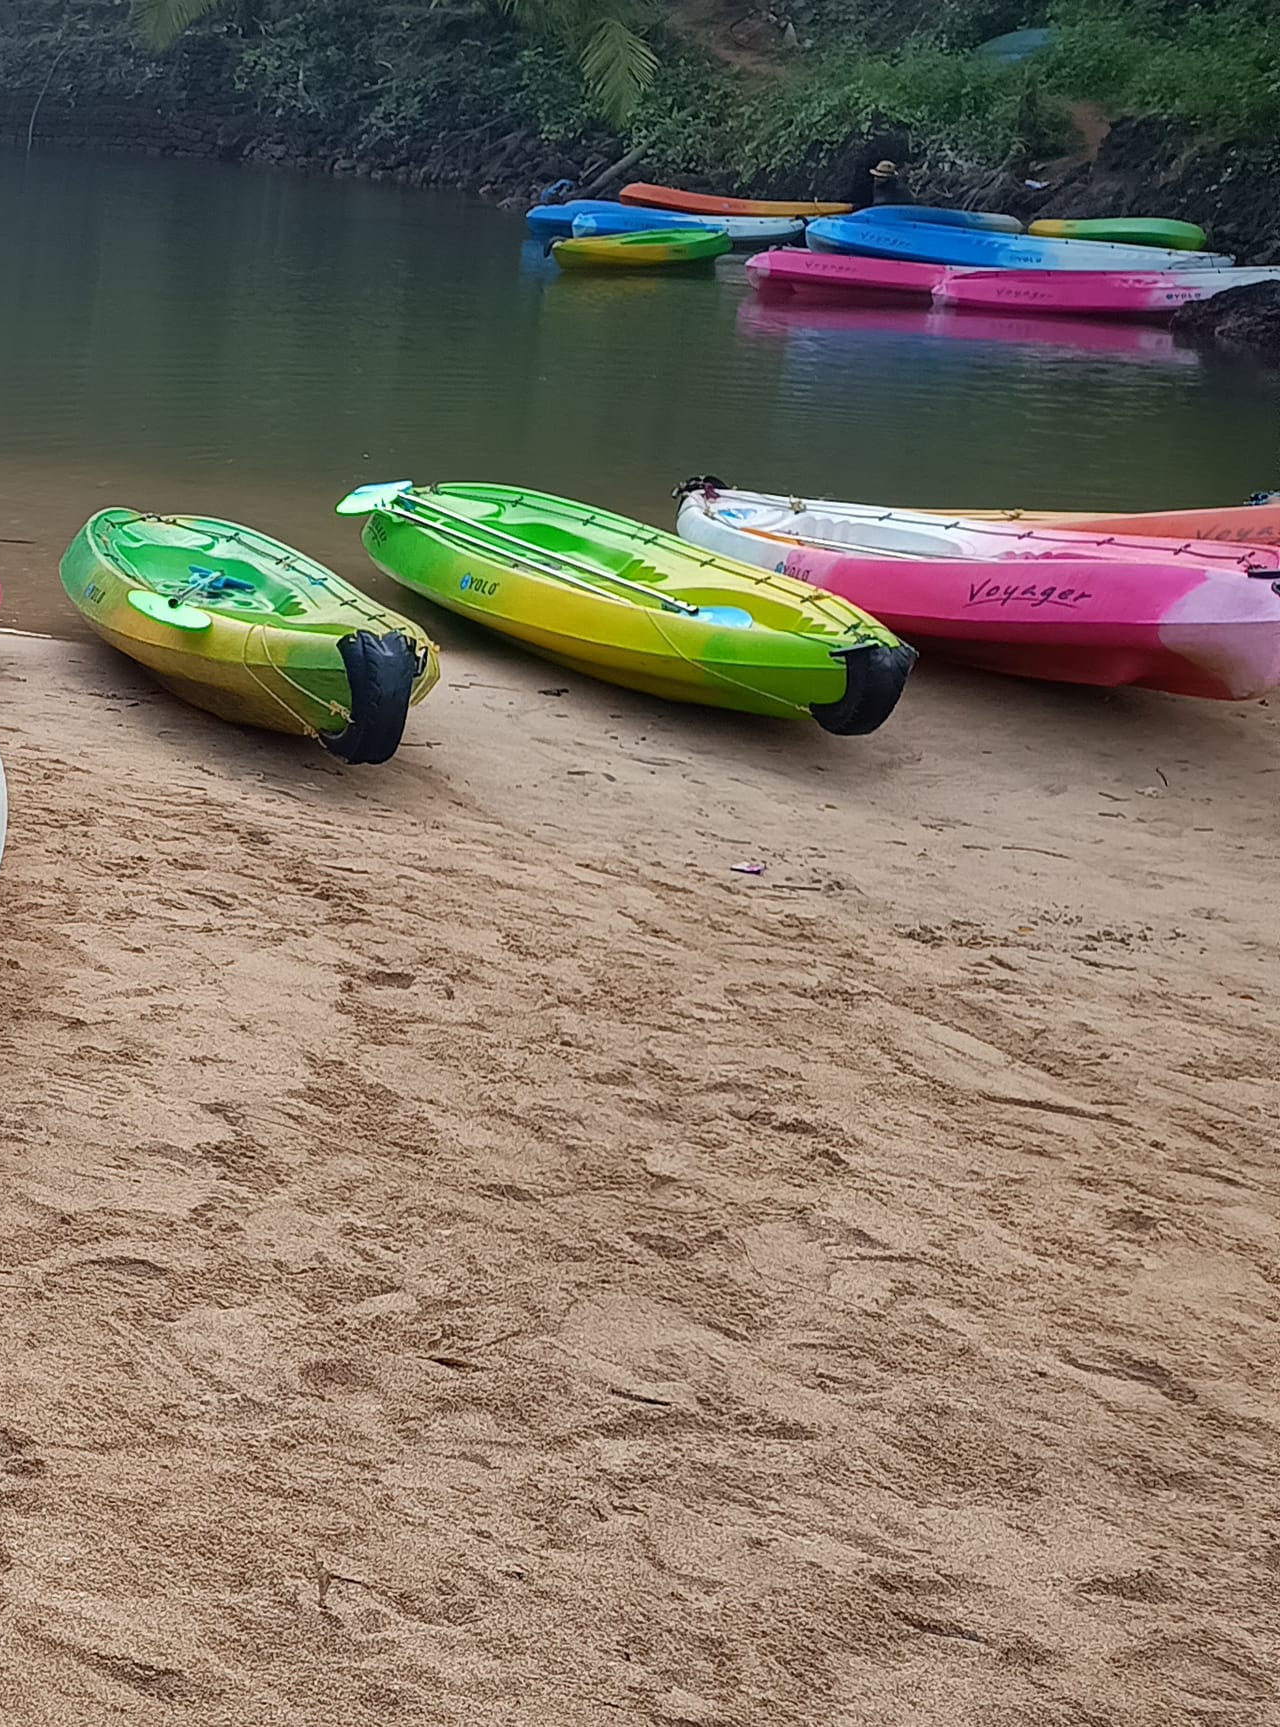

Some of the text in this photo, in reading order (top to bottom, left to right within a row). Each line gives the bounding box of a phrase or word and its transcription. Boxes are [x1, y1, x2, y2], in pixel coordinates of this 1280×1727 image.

[1196, 524, 1280, 541] Voya
[469, 576, 498, 596] YOLO
[968, 578, 1092, 607] Voyager
